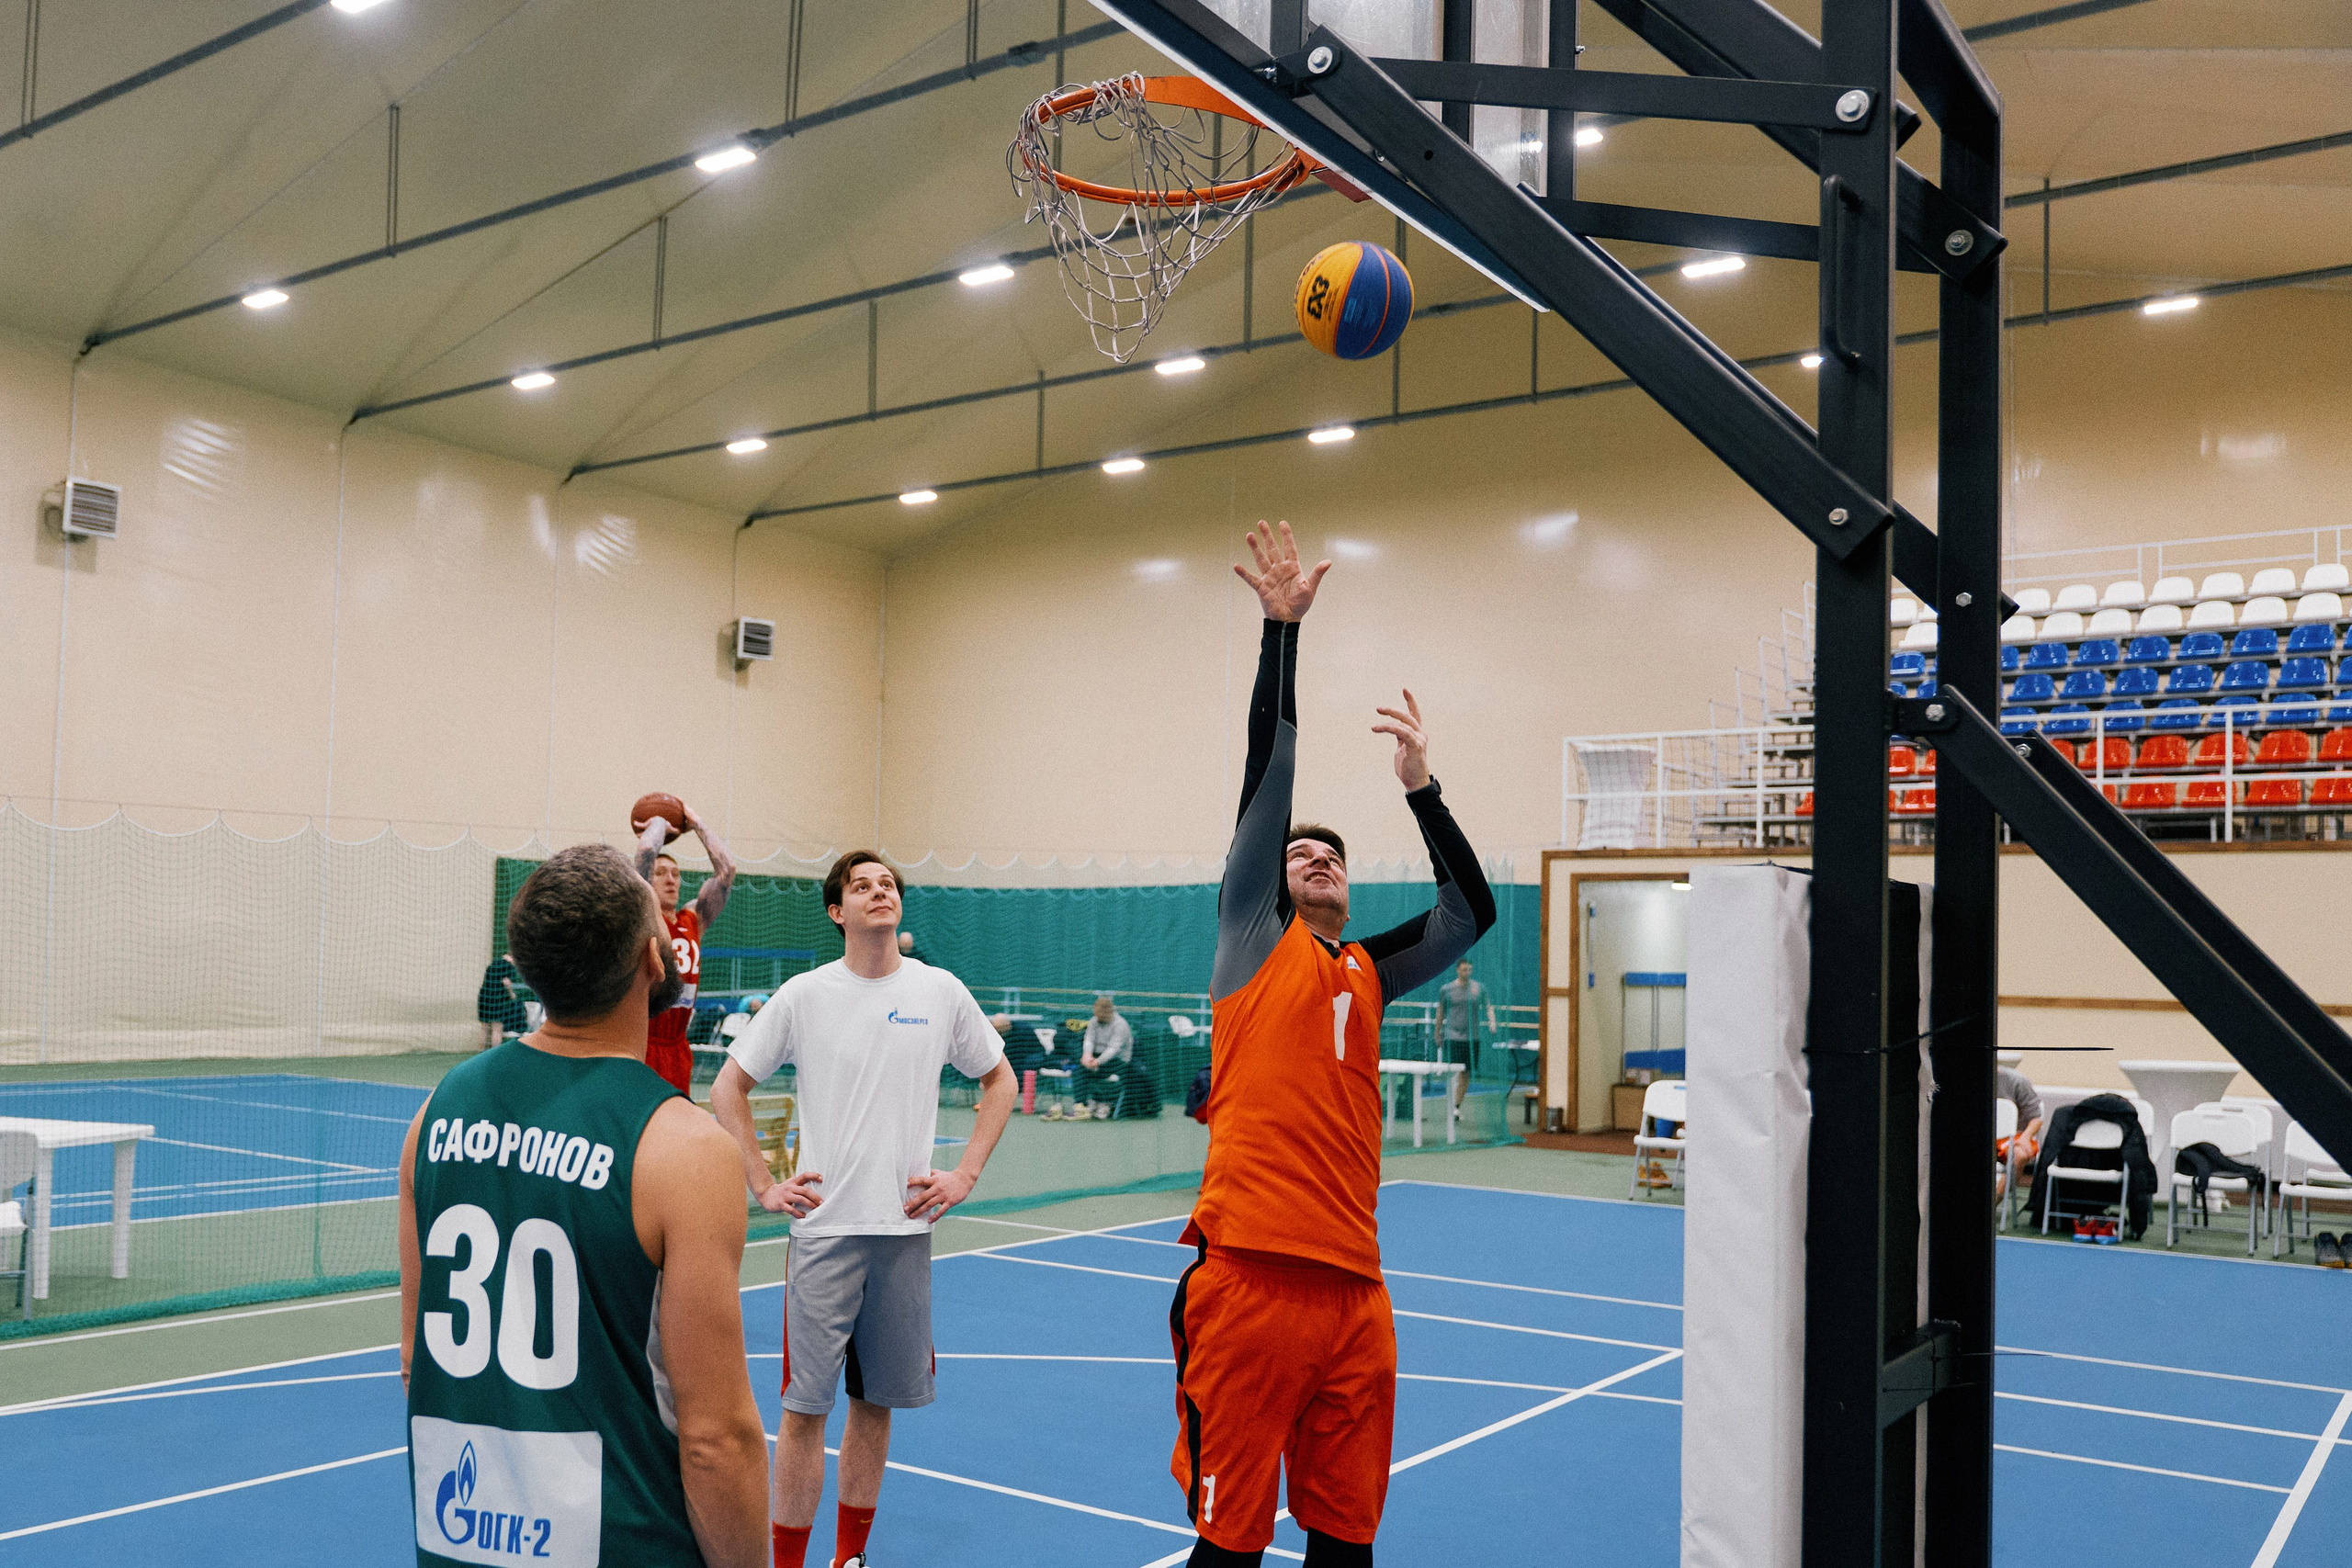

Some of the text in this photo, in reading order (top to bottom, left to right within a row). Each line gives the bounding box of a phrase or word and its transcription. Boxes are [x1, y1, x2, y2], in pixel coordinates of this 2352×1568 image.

[1332, 991, 1352, 1062] 1
[428, 1118, 615, 1190] САФРОНОВ
[424, 1203, 580, 1391] 30
[1203, 1473, 1216, 1524] 1
